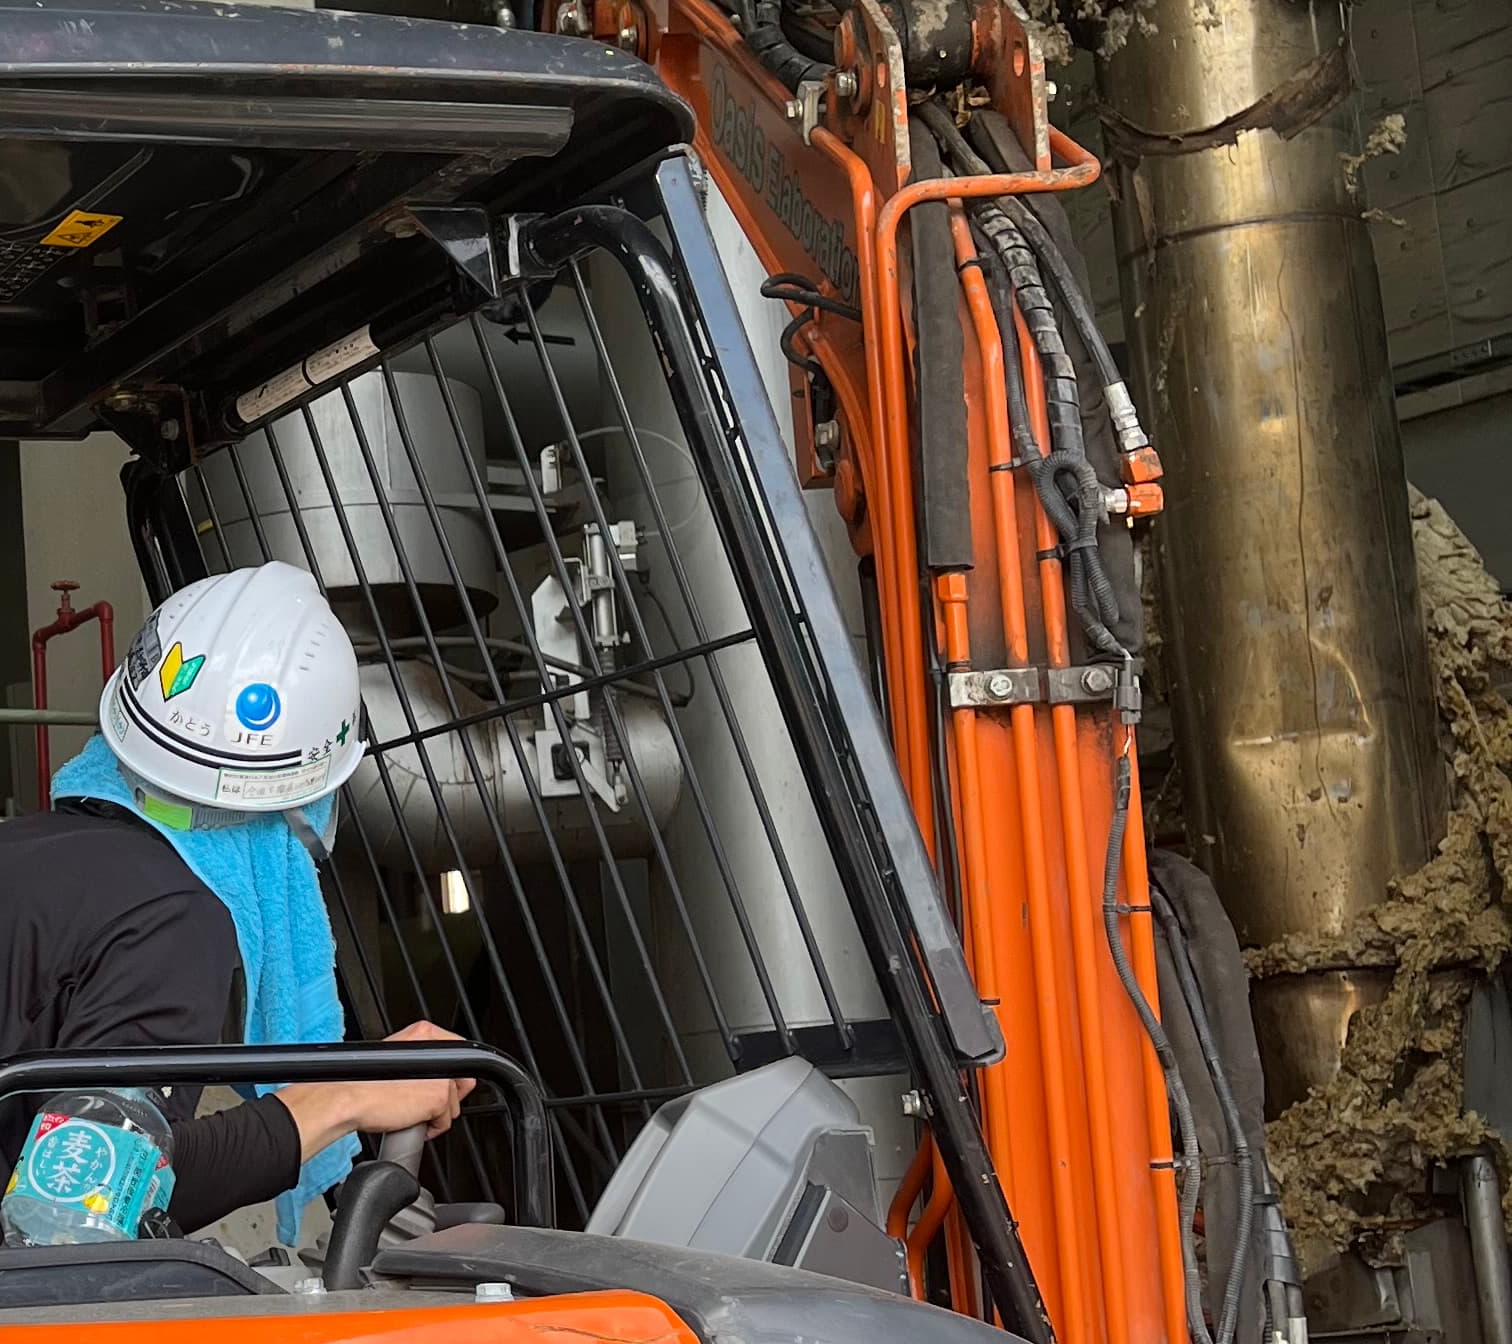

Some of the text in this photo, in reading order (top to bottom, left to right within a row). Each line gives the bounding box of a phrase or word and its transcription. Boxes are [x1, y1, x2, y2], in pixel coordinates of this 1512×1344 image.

[170, 711, 211, 737] かとう
[231, 731, 273, 746] JFE
[47, 1130, 92, 1194] 麦茶
